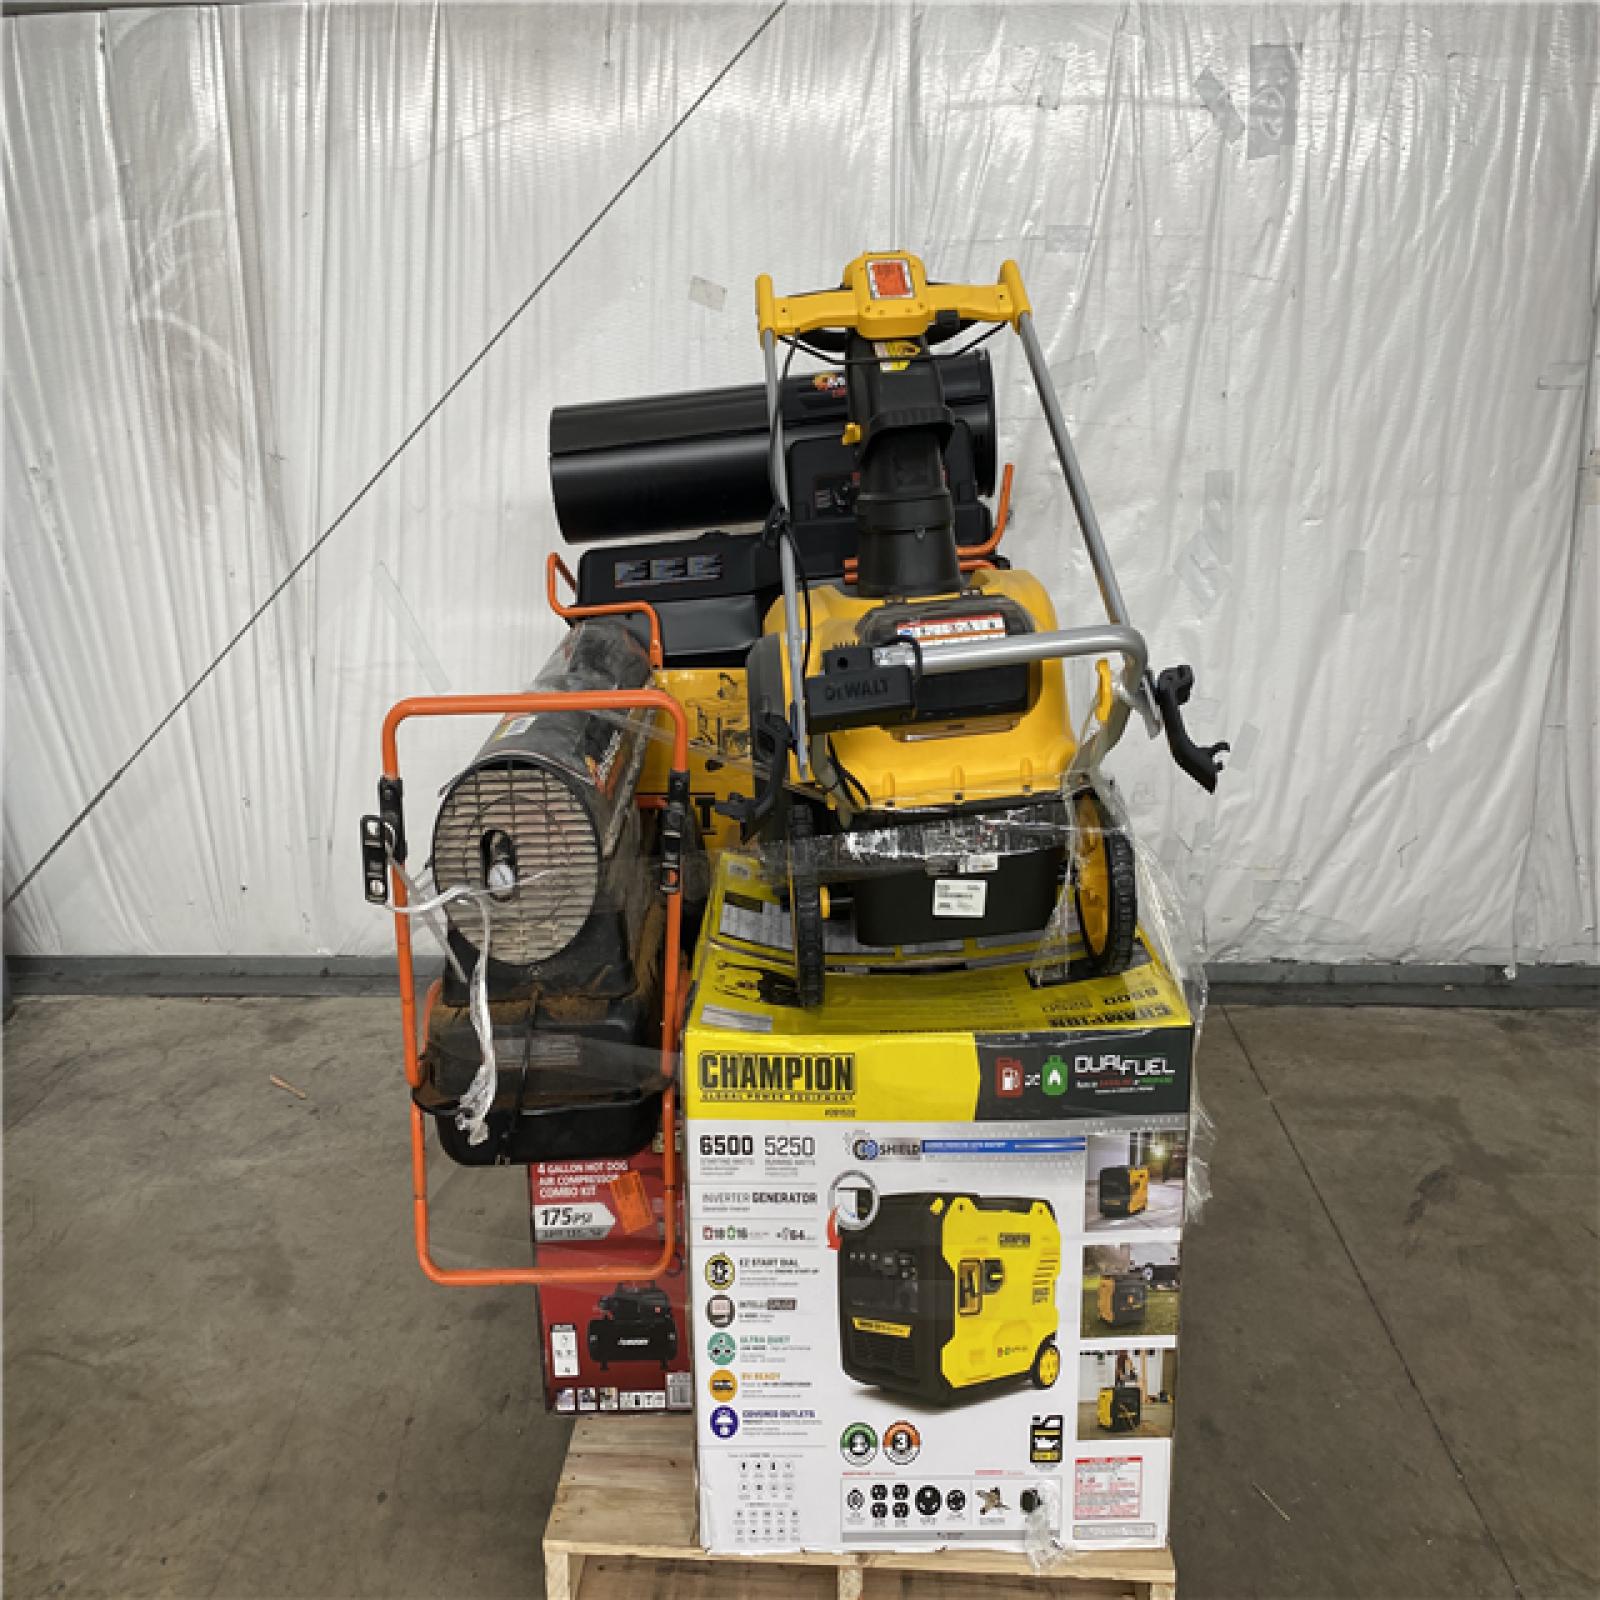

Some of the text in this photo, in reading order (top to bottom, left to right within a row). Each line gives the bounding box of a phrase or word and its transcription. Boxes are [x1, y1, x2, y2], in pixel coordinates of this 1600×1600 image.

[702, 1053, 853, 1091] CHAMPION
[699, 1134, 753, 1155] 6500
[764, 1135, 816, 1155] 5250
[879, 1144, 921, 1157] SHIELD
[547, 1162, 583, 1174] GALLON
[751, 1192, 818, 1203] GENERATOR
